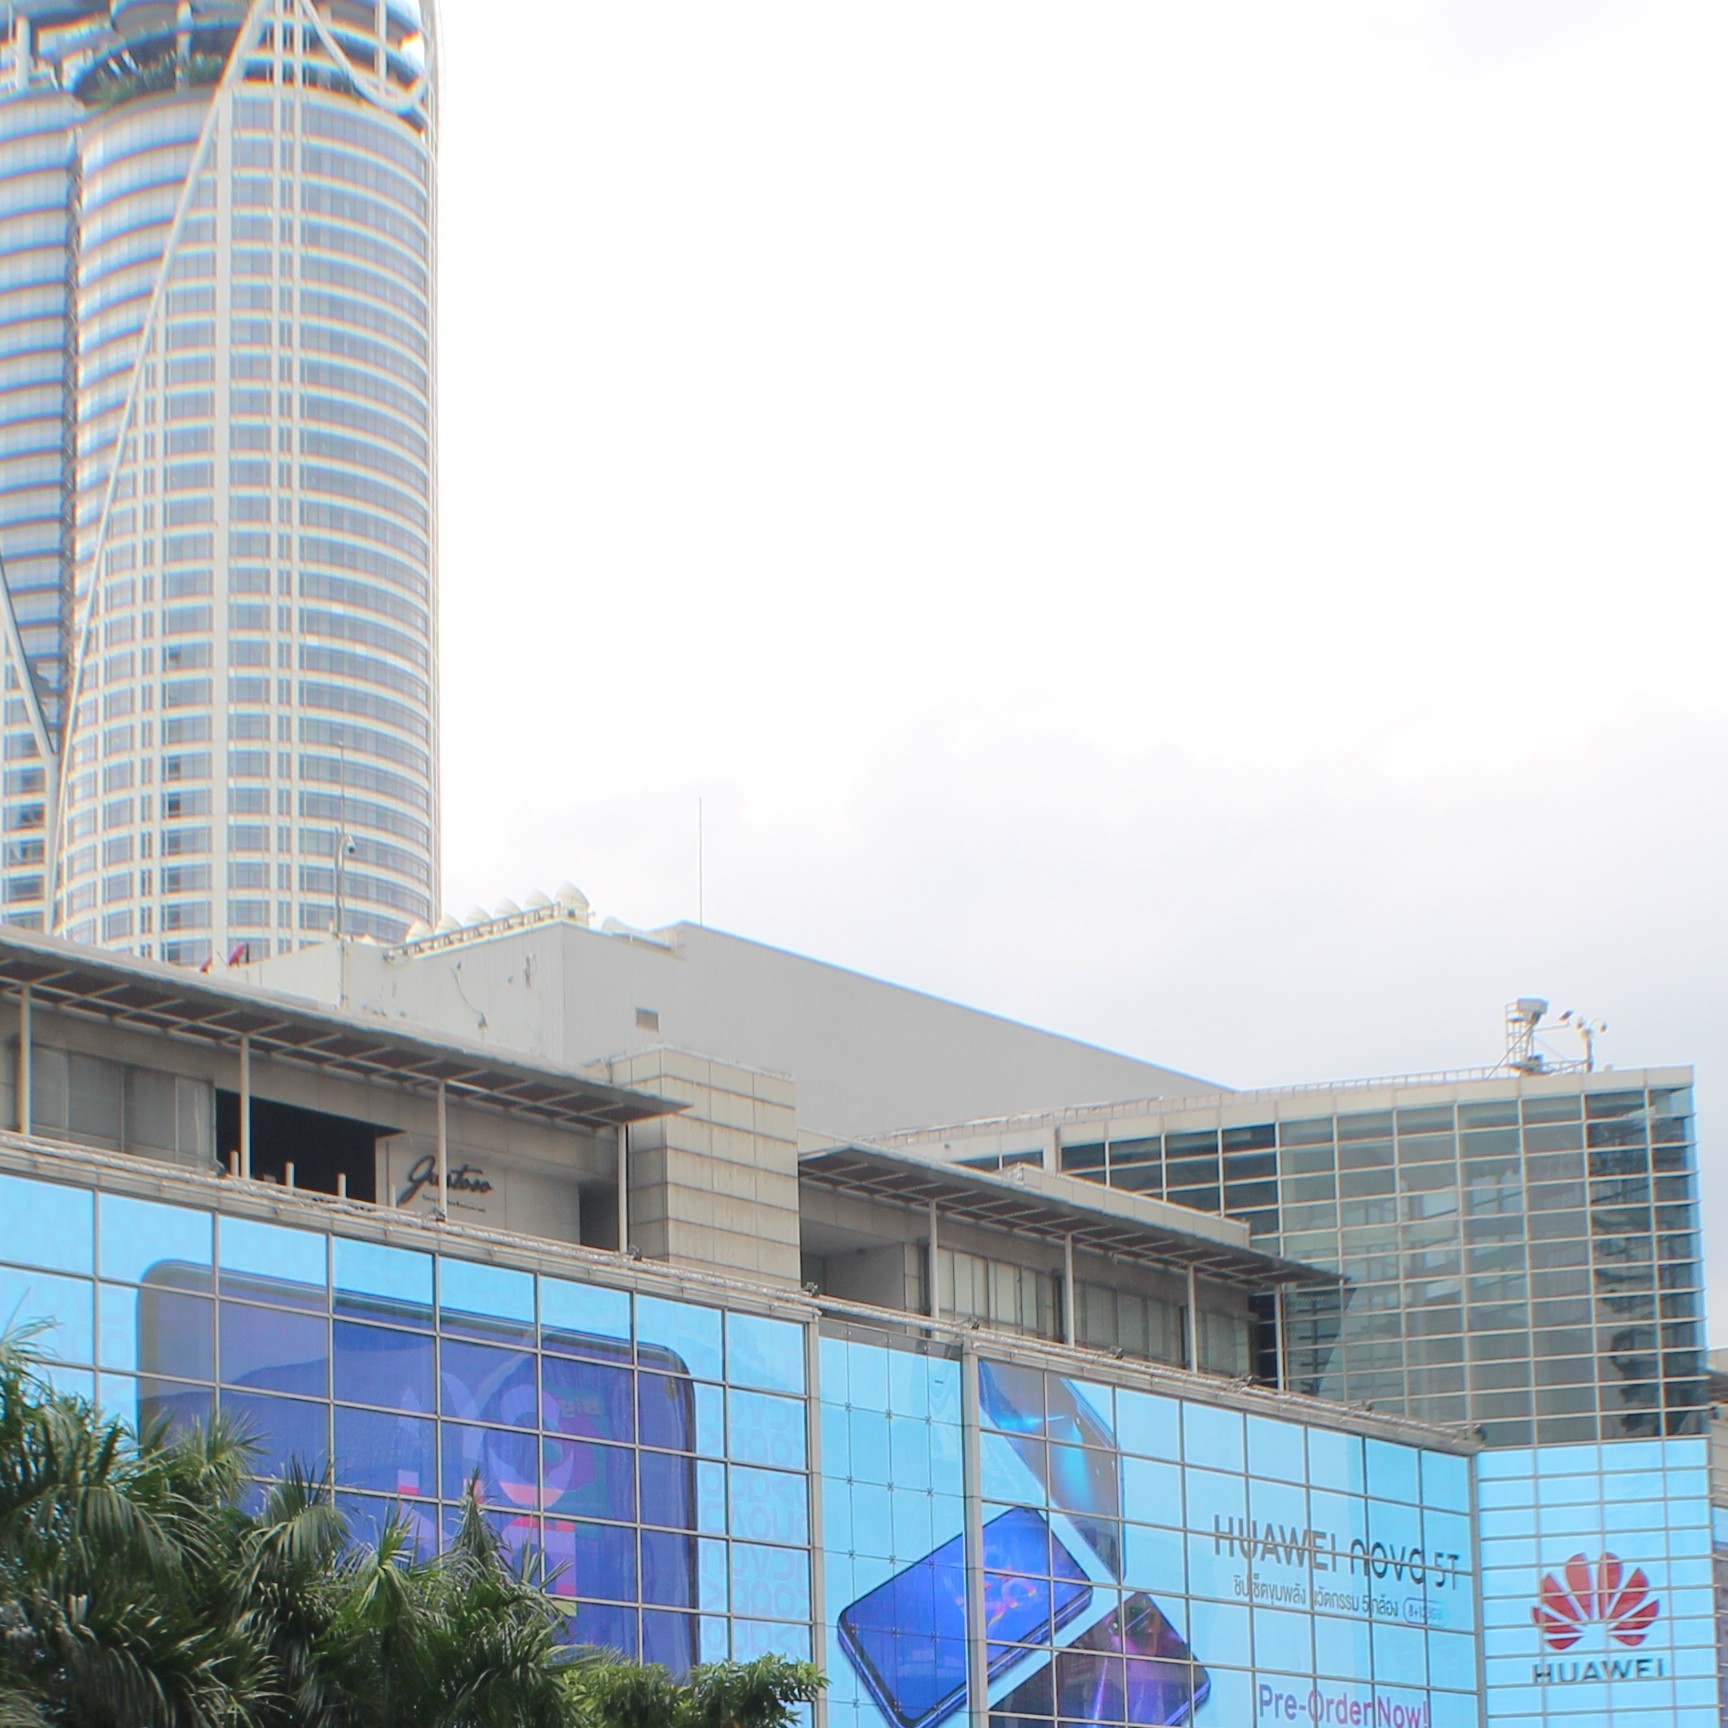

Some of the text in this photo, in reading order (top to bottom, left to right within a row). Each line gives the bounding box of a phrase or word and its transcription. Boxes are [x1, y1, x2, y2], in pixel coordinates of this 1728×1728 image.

[396, 1155, 494, 1205] Gutoso
[1213, 1513, 1337, 1573] HUAWEI
[1532, 1657, 1665, 1684] HUAWEI
[1258, 1683, 1372, 1727] Pre-Order
